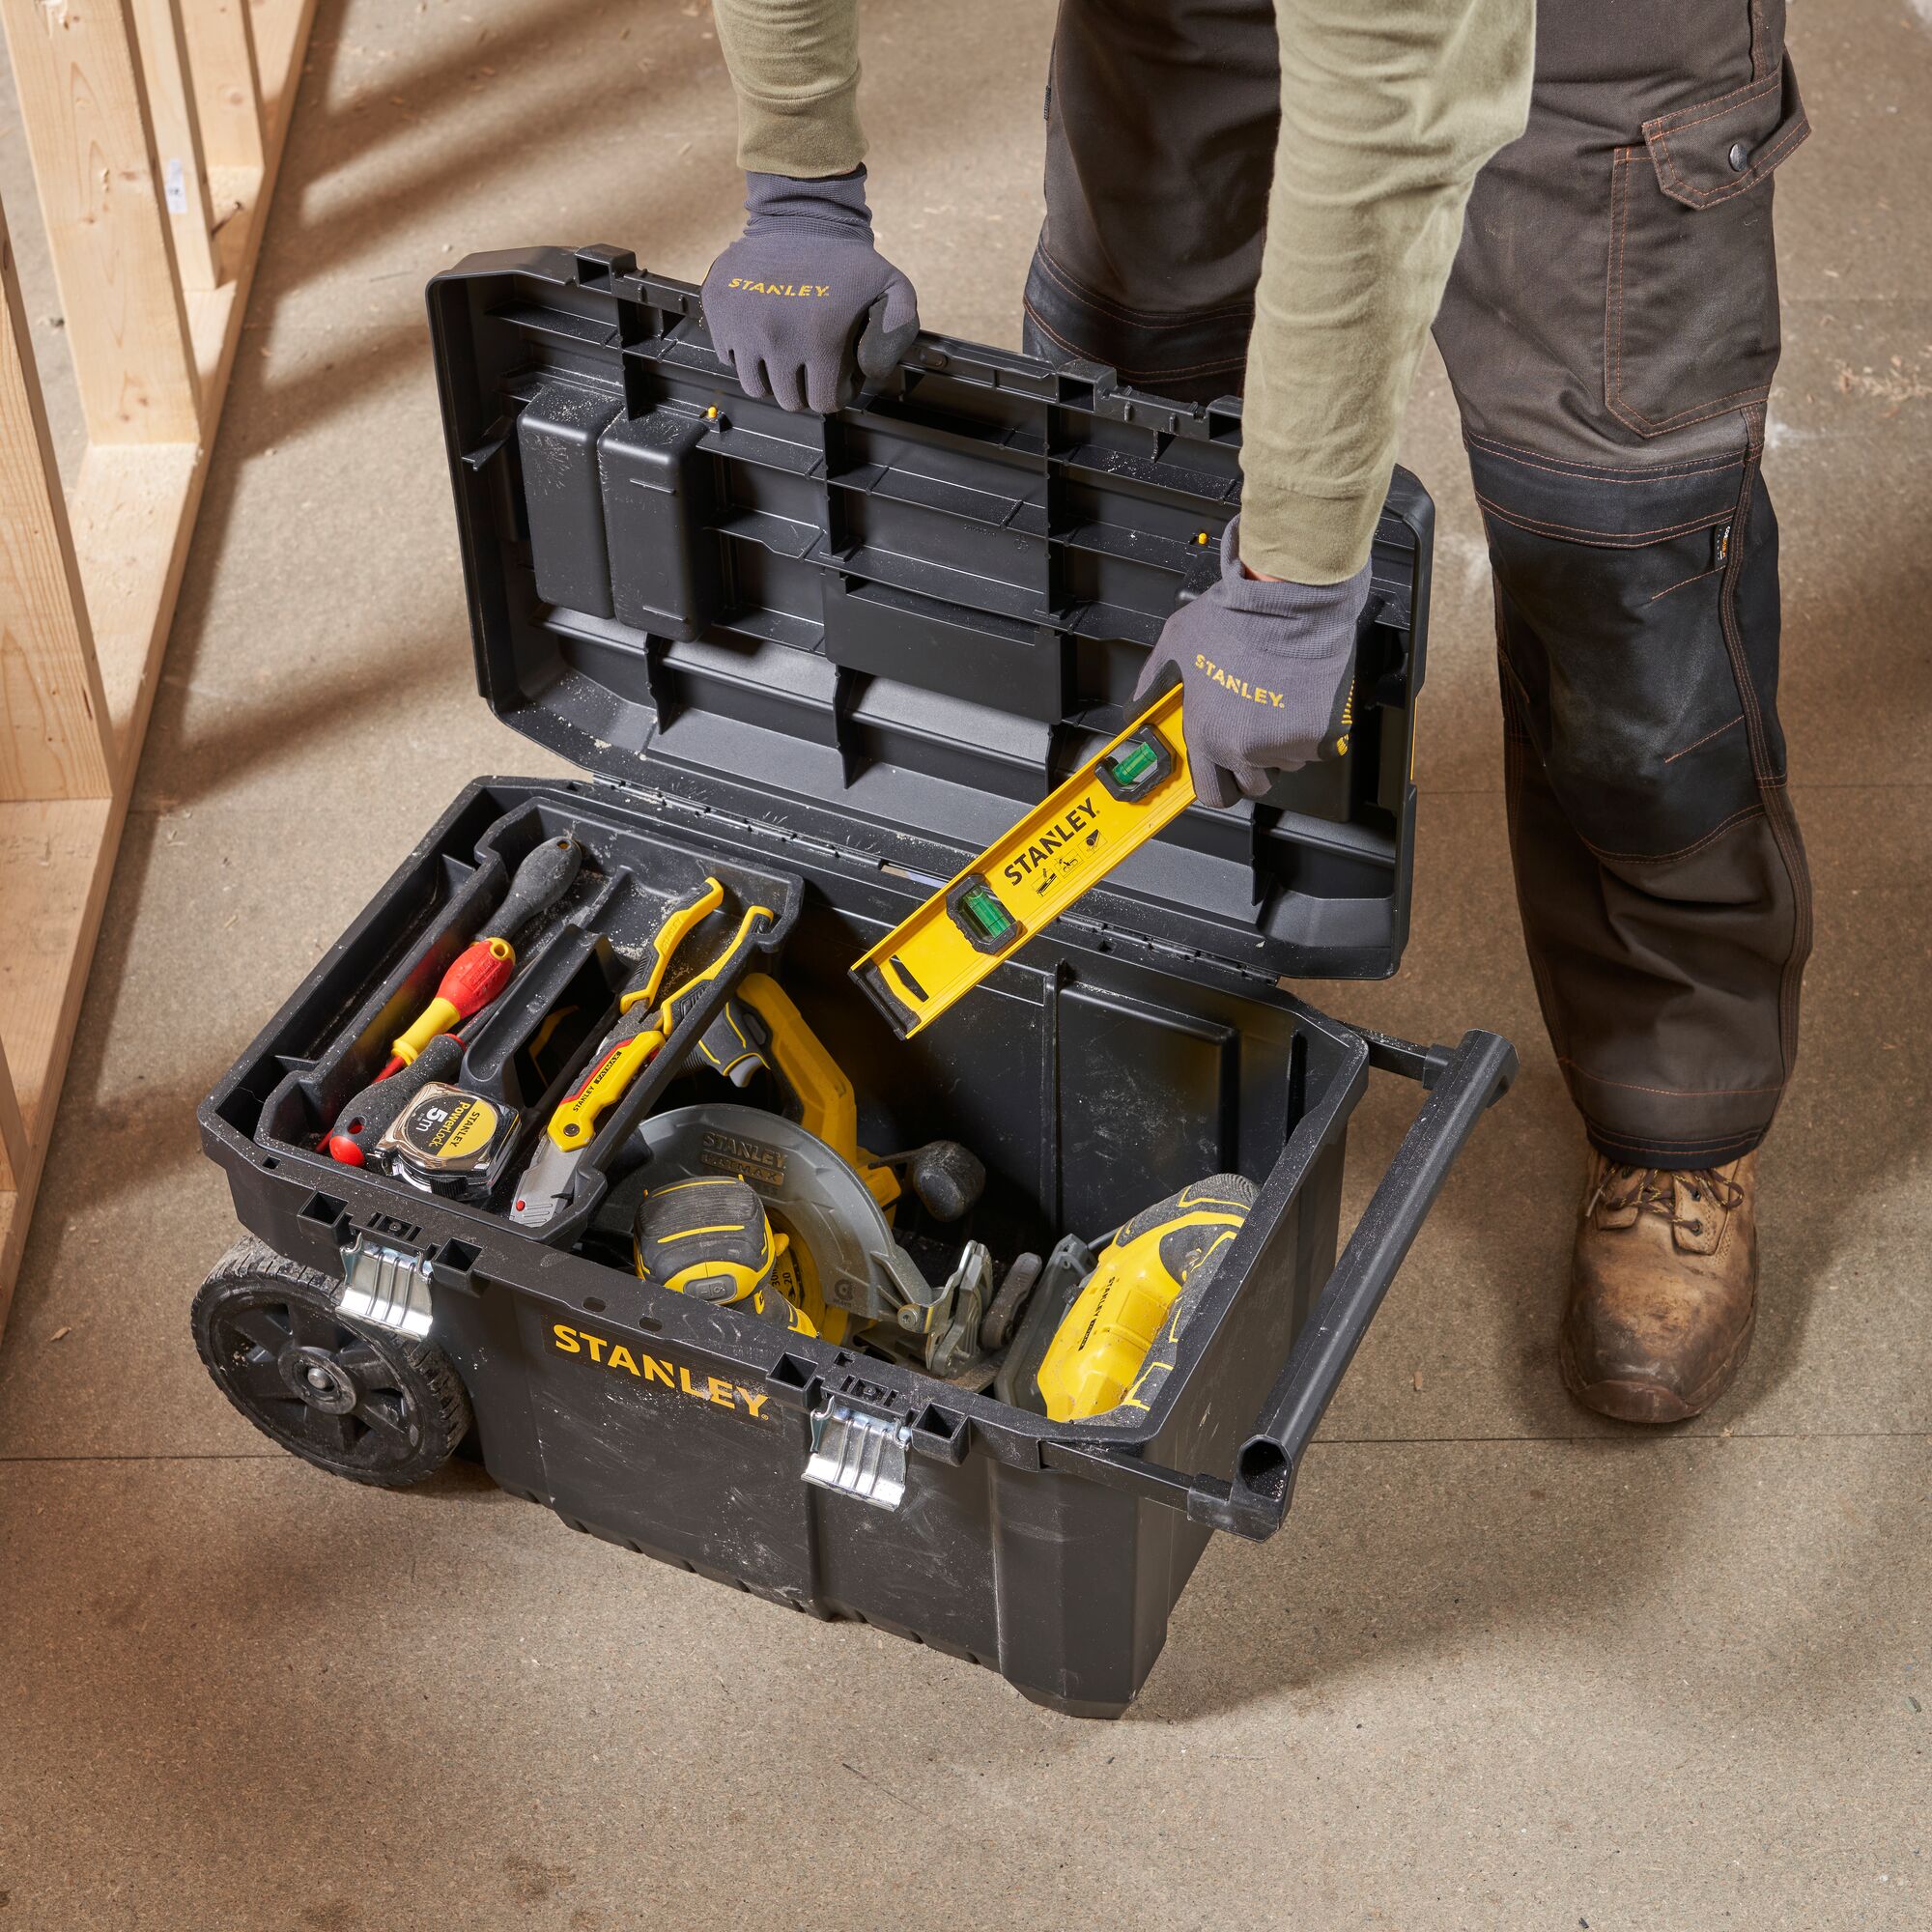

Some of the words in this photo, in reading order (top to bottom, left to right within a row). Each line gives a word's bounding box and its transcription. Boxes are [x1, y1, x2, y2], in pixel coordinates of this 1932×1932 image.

[727, 277, 830, 297] STANLEY
[1195, 654, 1284, 707] STANLEY
[1004, 796, 1097, 887] STANLEY
[573, 1086, 595, 1112] STANLEY
[415, 1107, 448, 1132] 5m
[450, 1111, 480, 1147] STANLEY
[702, 1131, 786, 1168] STANLEY
[553, 1323, 769, 1419] STANLEY
